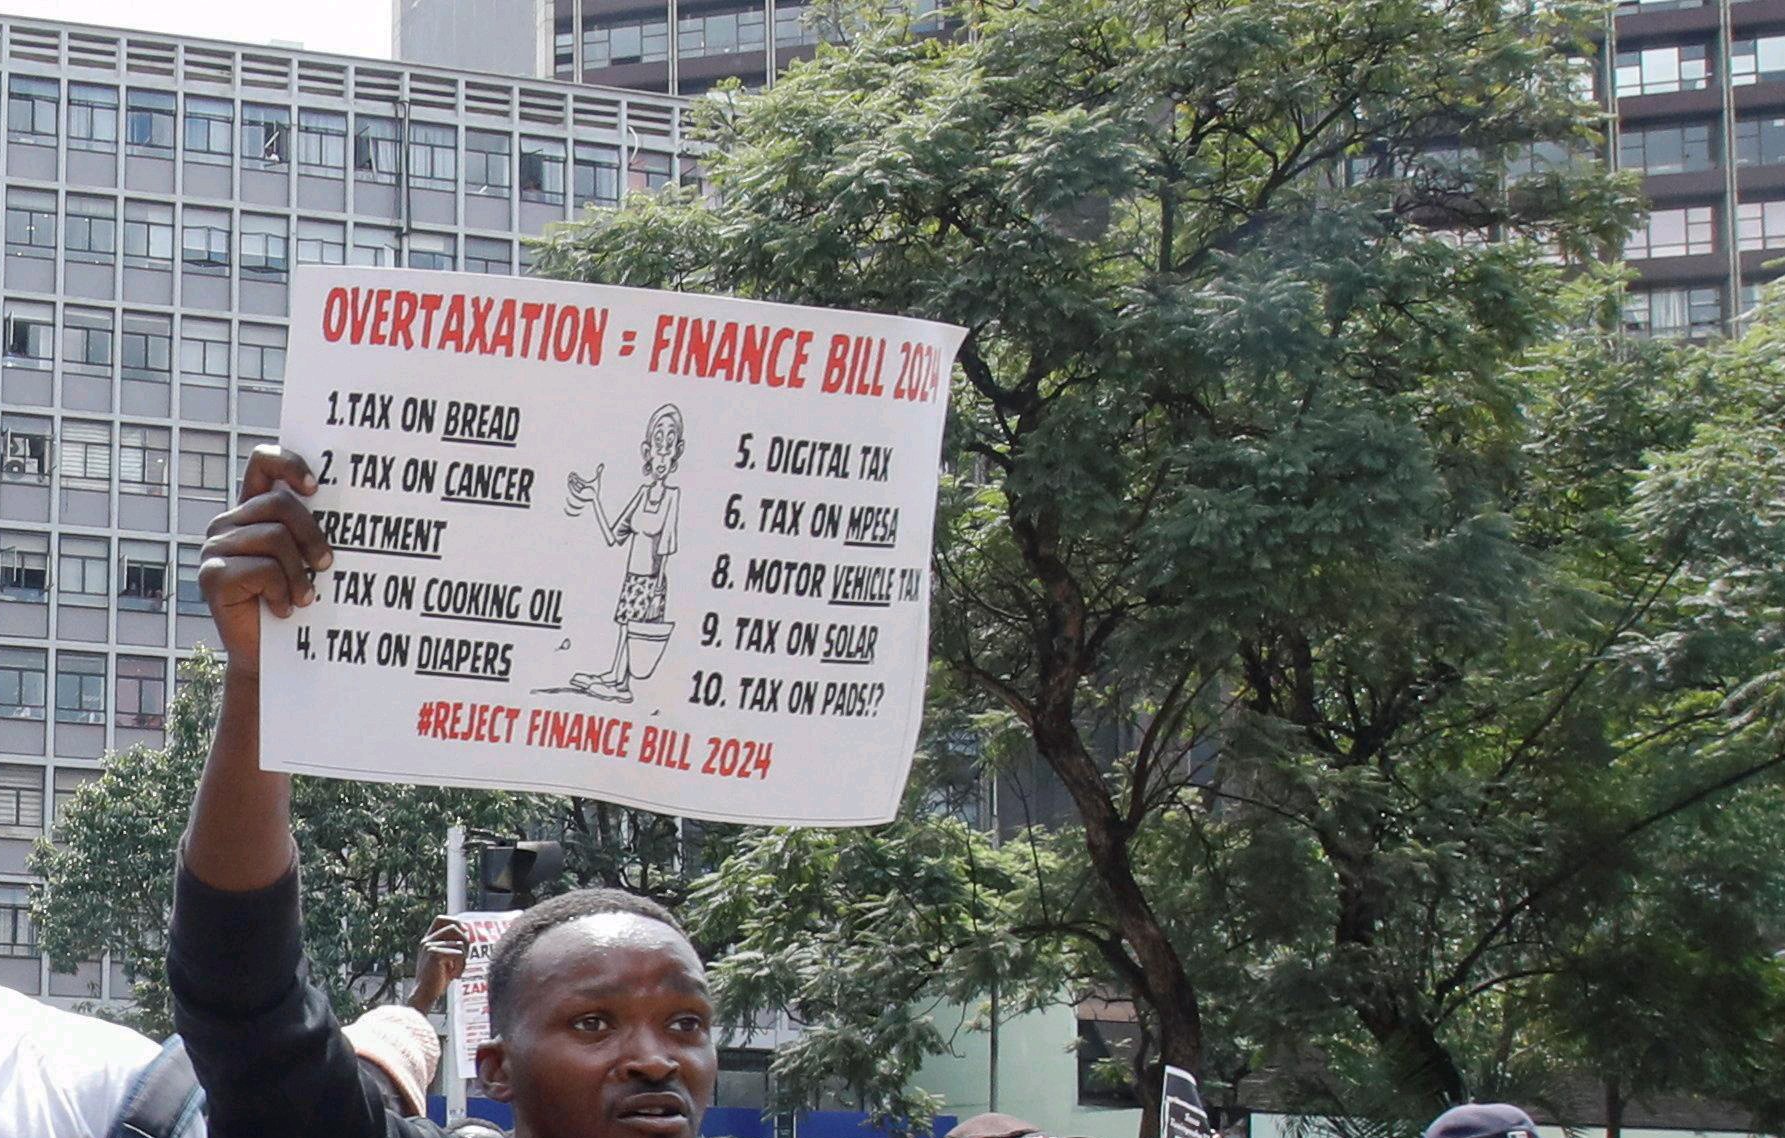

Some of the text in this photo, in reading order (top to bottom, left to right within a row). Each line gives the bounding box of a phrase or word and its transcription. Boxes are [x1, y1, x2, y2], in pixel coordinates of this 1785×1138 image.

[323, 287, 609, 366] OVERTAXATION
[619, 330, 637, 357] =
[650, 315, 814, 389] FINANCE
[822, 334, 887, 398] BILL
[401, 396, 437, 434] ON
[441, 400, 520, 442] BREAD
[316, 449, 535, 505] 2. TAX ON CANCER
[735, 432, 892, 481] 5. DIGITAL TAX
[724, 493, 899, 545] 6. TAX ON MPESA
[333, 570, 377, 607] TAX
[383, 574, 416, 610] ON
[421, 577, 522, 620] COOKING
[527, 588, 563, 625] OIL
[711, 553, 922, 602] 8. MOTOR VEHICLE TAX
[296, 625, 514, 679] 4. TAX ON DIAPERS
[701, 611, 878, 663] 9. TAX ON SOLAR
[688, 670, 884, 717] 10. TAX ON PADS!?
[418, 702, 771, 778] #REJECT FINANCE BILL 2024
